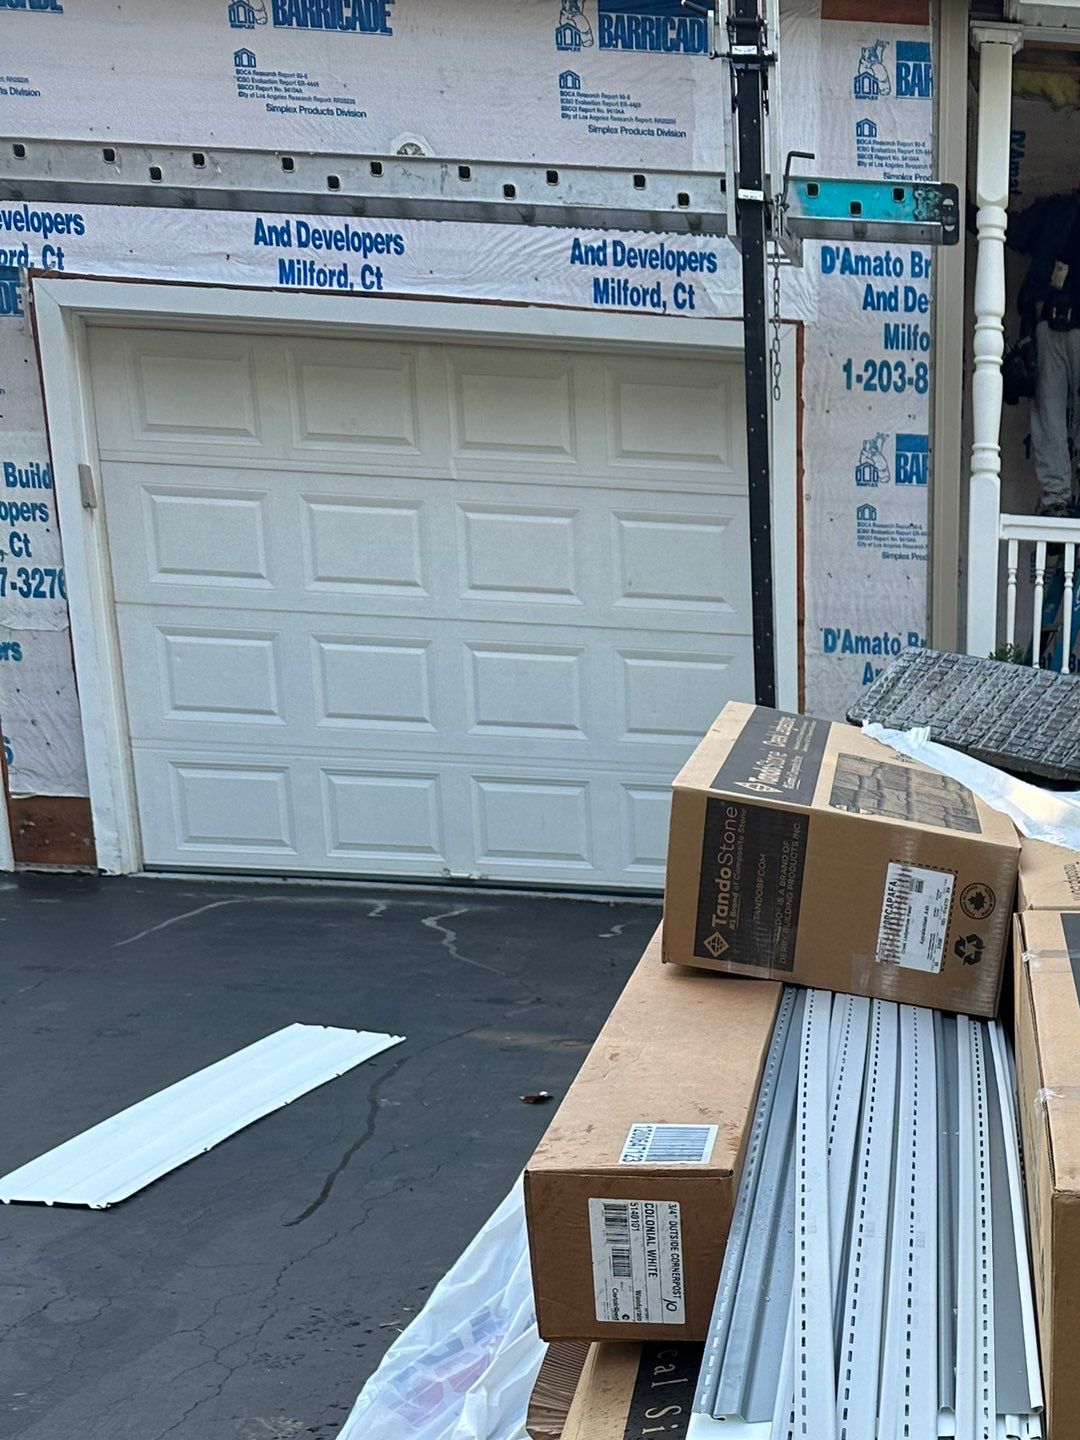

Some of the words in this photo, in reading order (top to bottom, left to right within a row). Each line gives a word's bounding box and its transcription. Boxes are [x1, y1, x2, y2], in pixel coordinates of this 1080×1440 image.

[600, 13, 709, 53] BARRICAD
[266, 103, 298, 114] Simplex
[299, 105, 335, 116] Products
[336, 108, 367, 118] Division
[588, 124, 618, 135] Simplex
[620, 126, 655, 137] Products
[656, 129, 687, 138] Division
[0, 204, 85, 239] velopers
[254, 217, 292, 248] And
[296, 220, 405, 259] Developers
[570, 237, 608, 266] And
[612, 239, 718, 277] Developers
[820, 246, 904, 277] D'Amato
[278, 258, 354, 290] Milford,
[361, 264, 384, 290] Ct
[593, 277, 667, 313] Milford,
[673, 281, 696, 310] Ct
[862, 283, 899, 312] And
[9, 531, 32, 558] Ct
[823, 628, 901, 656] D'Amato
[712, 806, 738, 928] TandoStone
[644, 1203, 656, 1246] COLONIAL
[669, 1220, 680, 1252] OUTSIDE
[647, 1248, 658, 1278] WHITE
[670, 1253, 682, 1300] CORNERPOST
